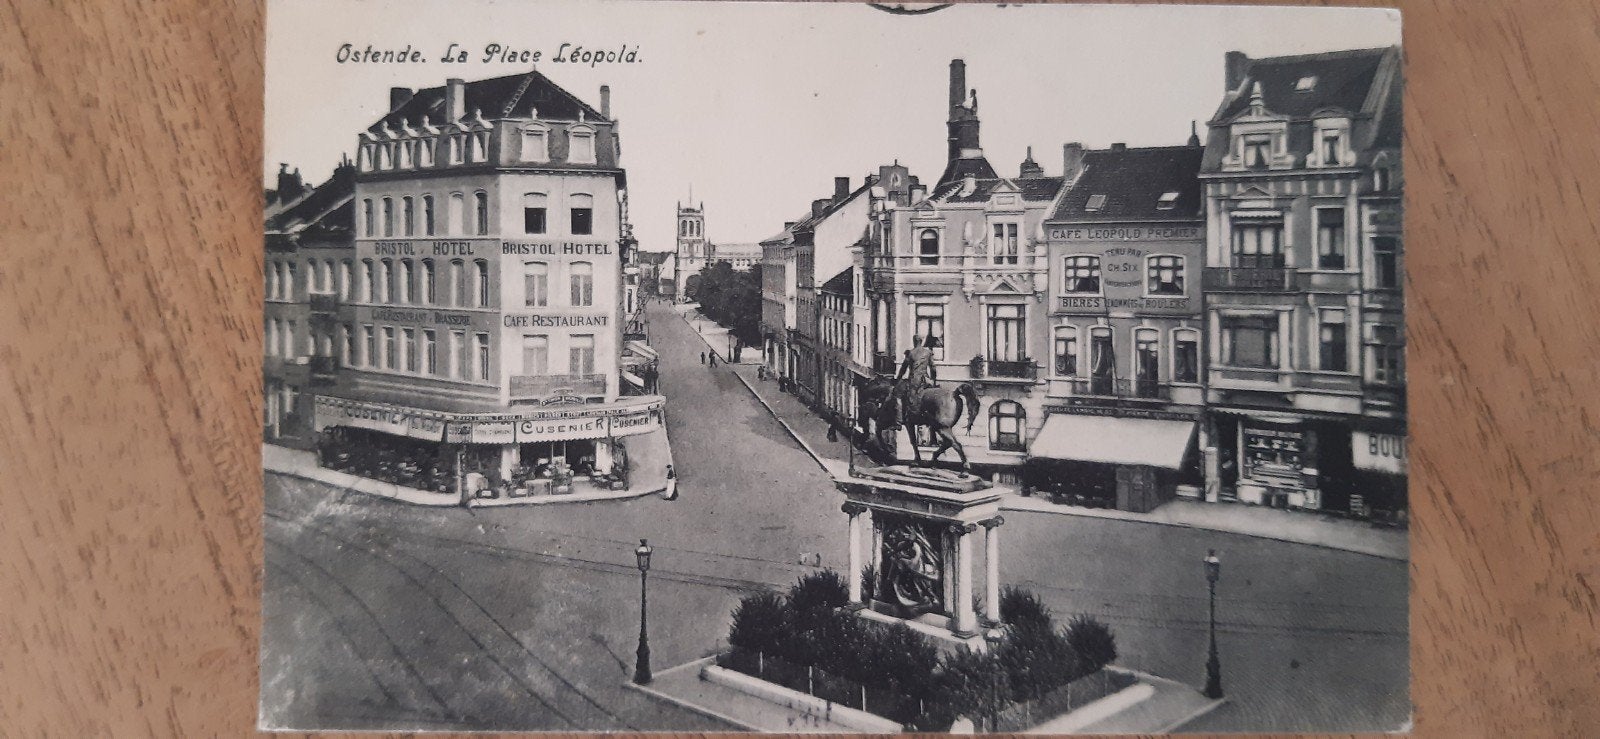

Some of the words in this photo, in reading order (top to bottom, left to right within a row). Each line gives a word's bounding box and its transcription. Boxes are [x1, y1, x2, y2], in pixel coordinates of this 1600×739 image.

[336, 43, 427, 64] Ostende.
[440, 43, 469, 63] La
[482, 43, 542, 64] Place
[552, 43, 643, 67] Léopold.
[1087, 229, 1141, 239] LEOPOLD
[1148, 228, 1198, 239] PREMIER
[375, 242, 416, 255] BRISTOL
[433, 242, 475, 255] HOTEL
[502, 242, 556, 255] BRISTOL
[563, 242, 613, 255] HOTEL
[532, 314, 609, 328] RESTAURANT
[521, 418, 605, 435] CUSENIER
[612, 413, 649, 429] CUSENIER
